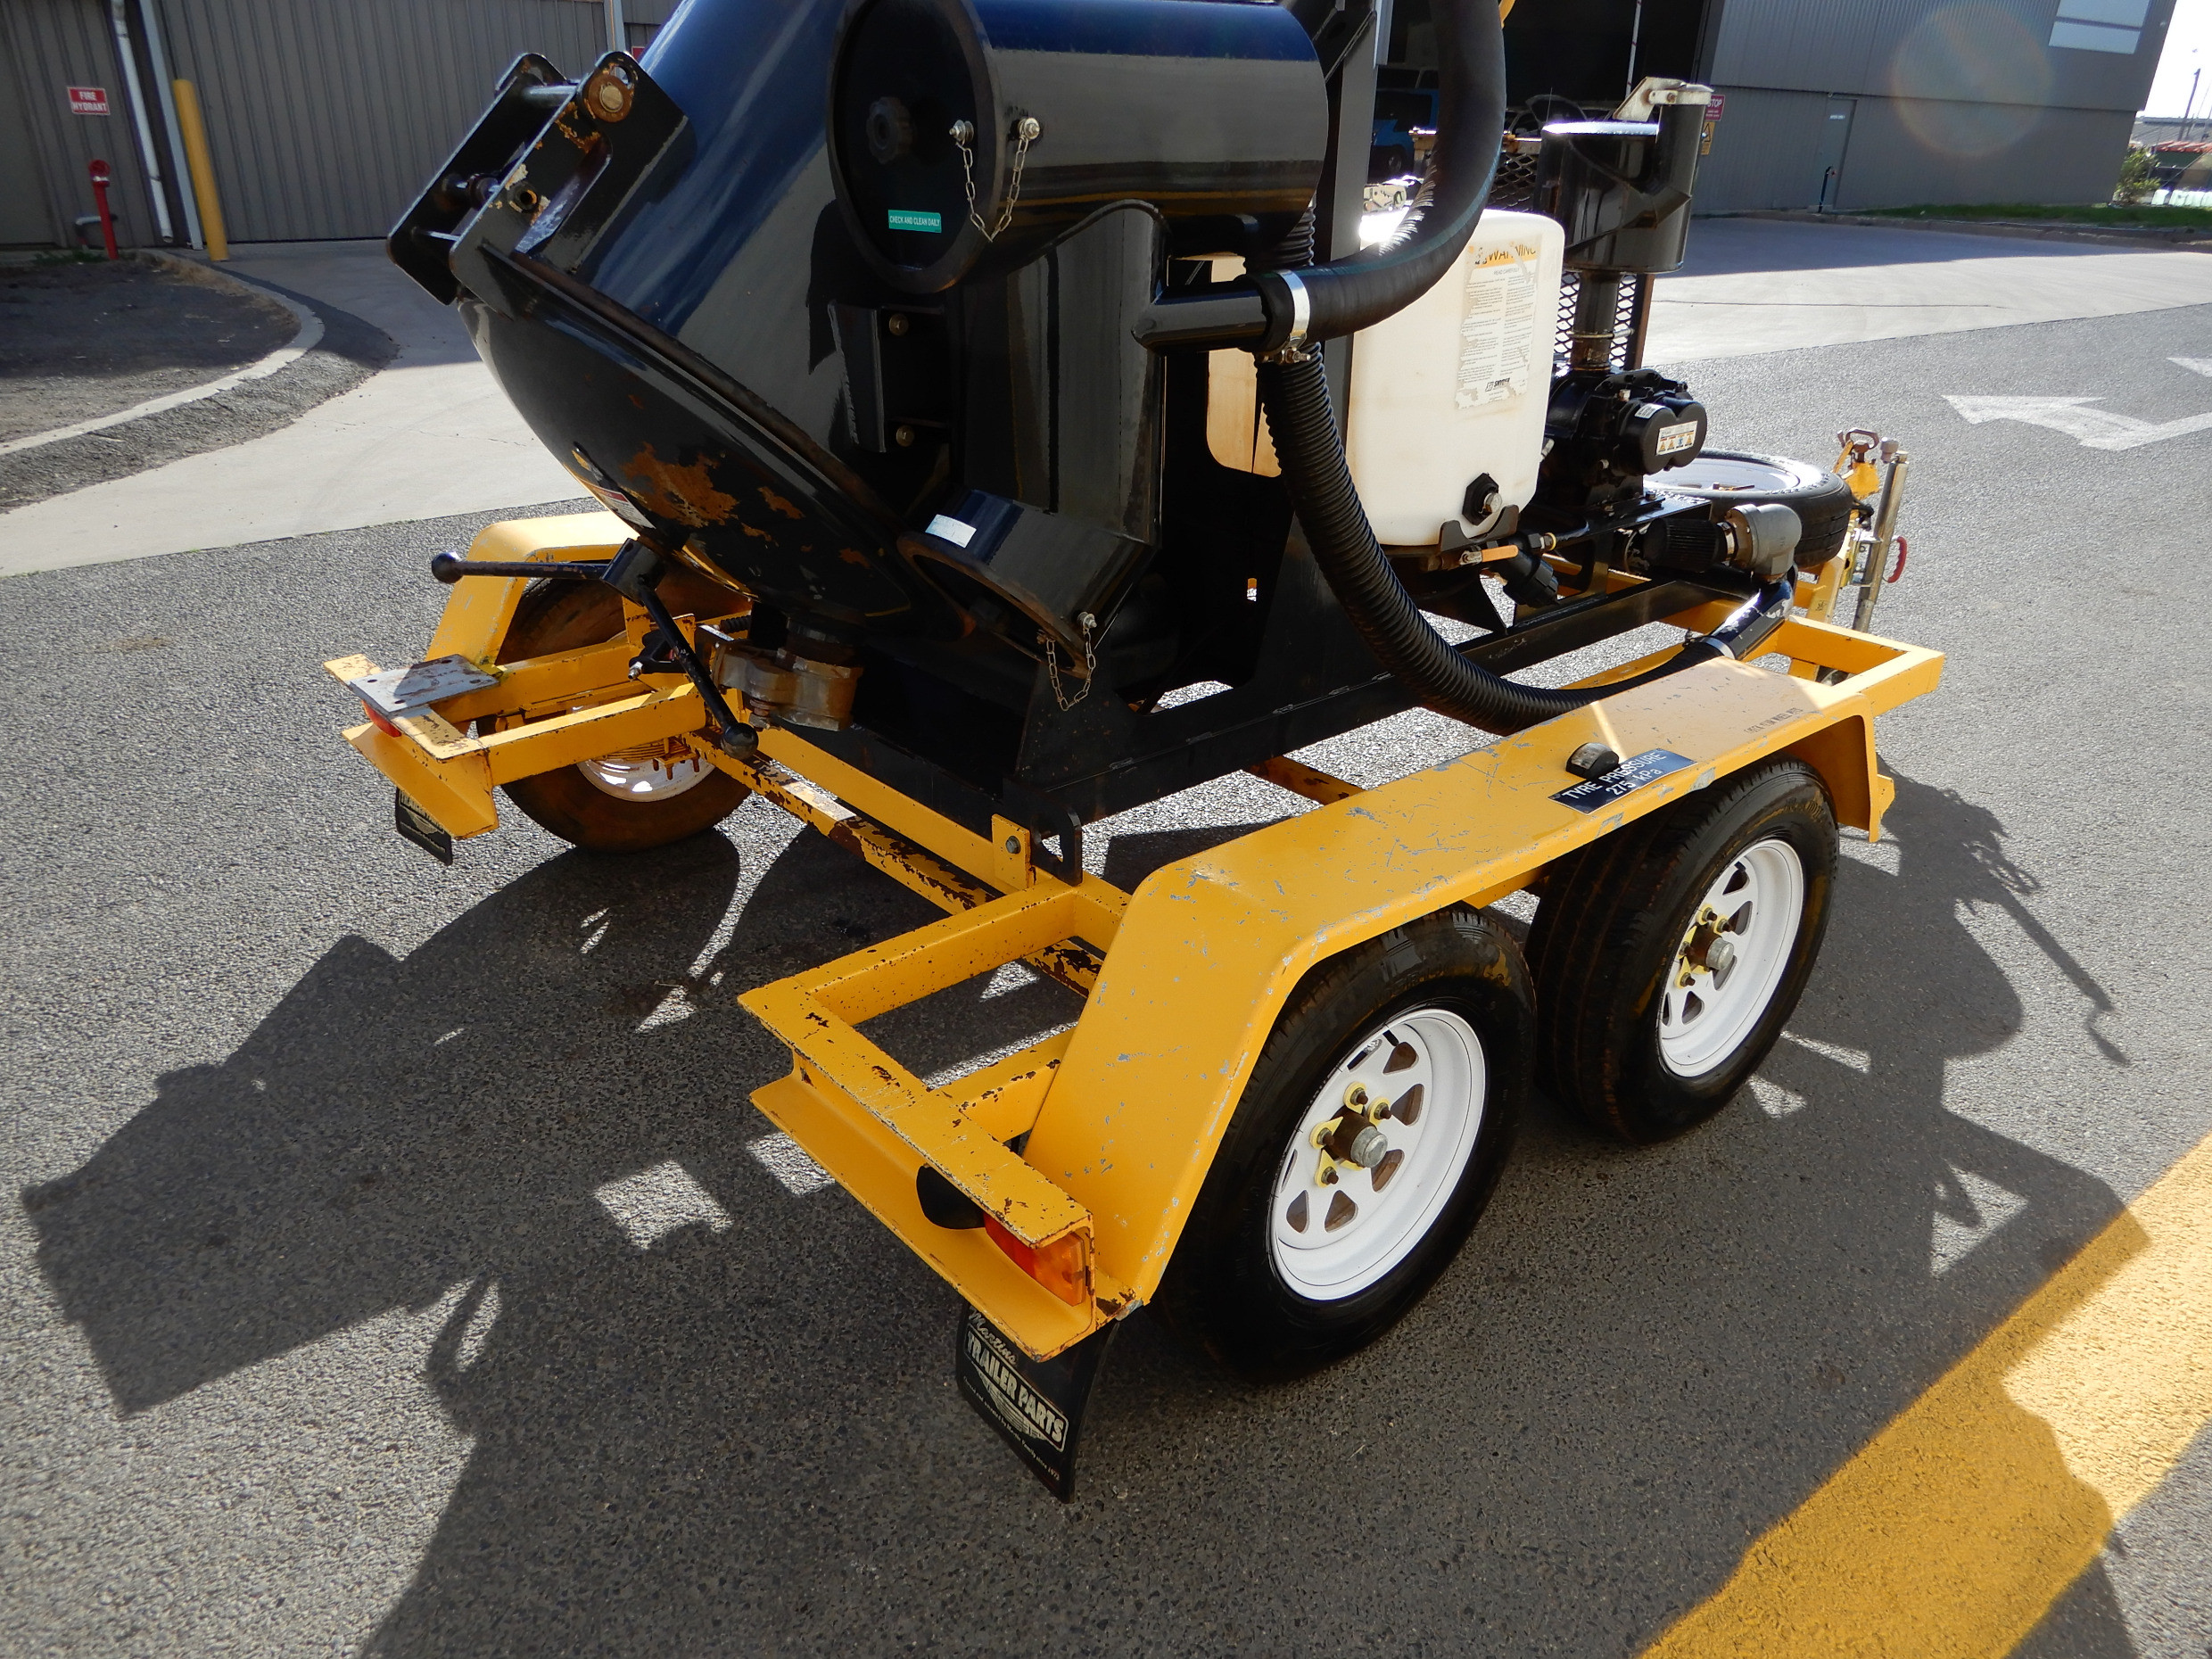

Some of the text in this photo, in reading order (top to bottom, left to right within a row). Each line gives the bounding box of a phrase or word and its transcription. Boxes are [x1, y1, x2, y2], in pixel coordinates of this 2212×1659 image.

[71, 103, 107, 111] HYDRANT
[79, 91, 97, 102] FIRE
[889, 215, 941, 227] CHECK AND CLEAN DAILY
[1562, 752, 1667, 799] TYRE PRESSURE
[1605, 768, 1663, 796] 275 kPa
[968, 1305, 1018, 1366] Martins
[967, 1330, 1064, 1443] TRAILER PARTS
